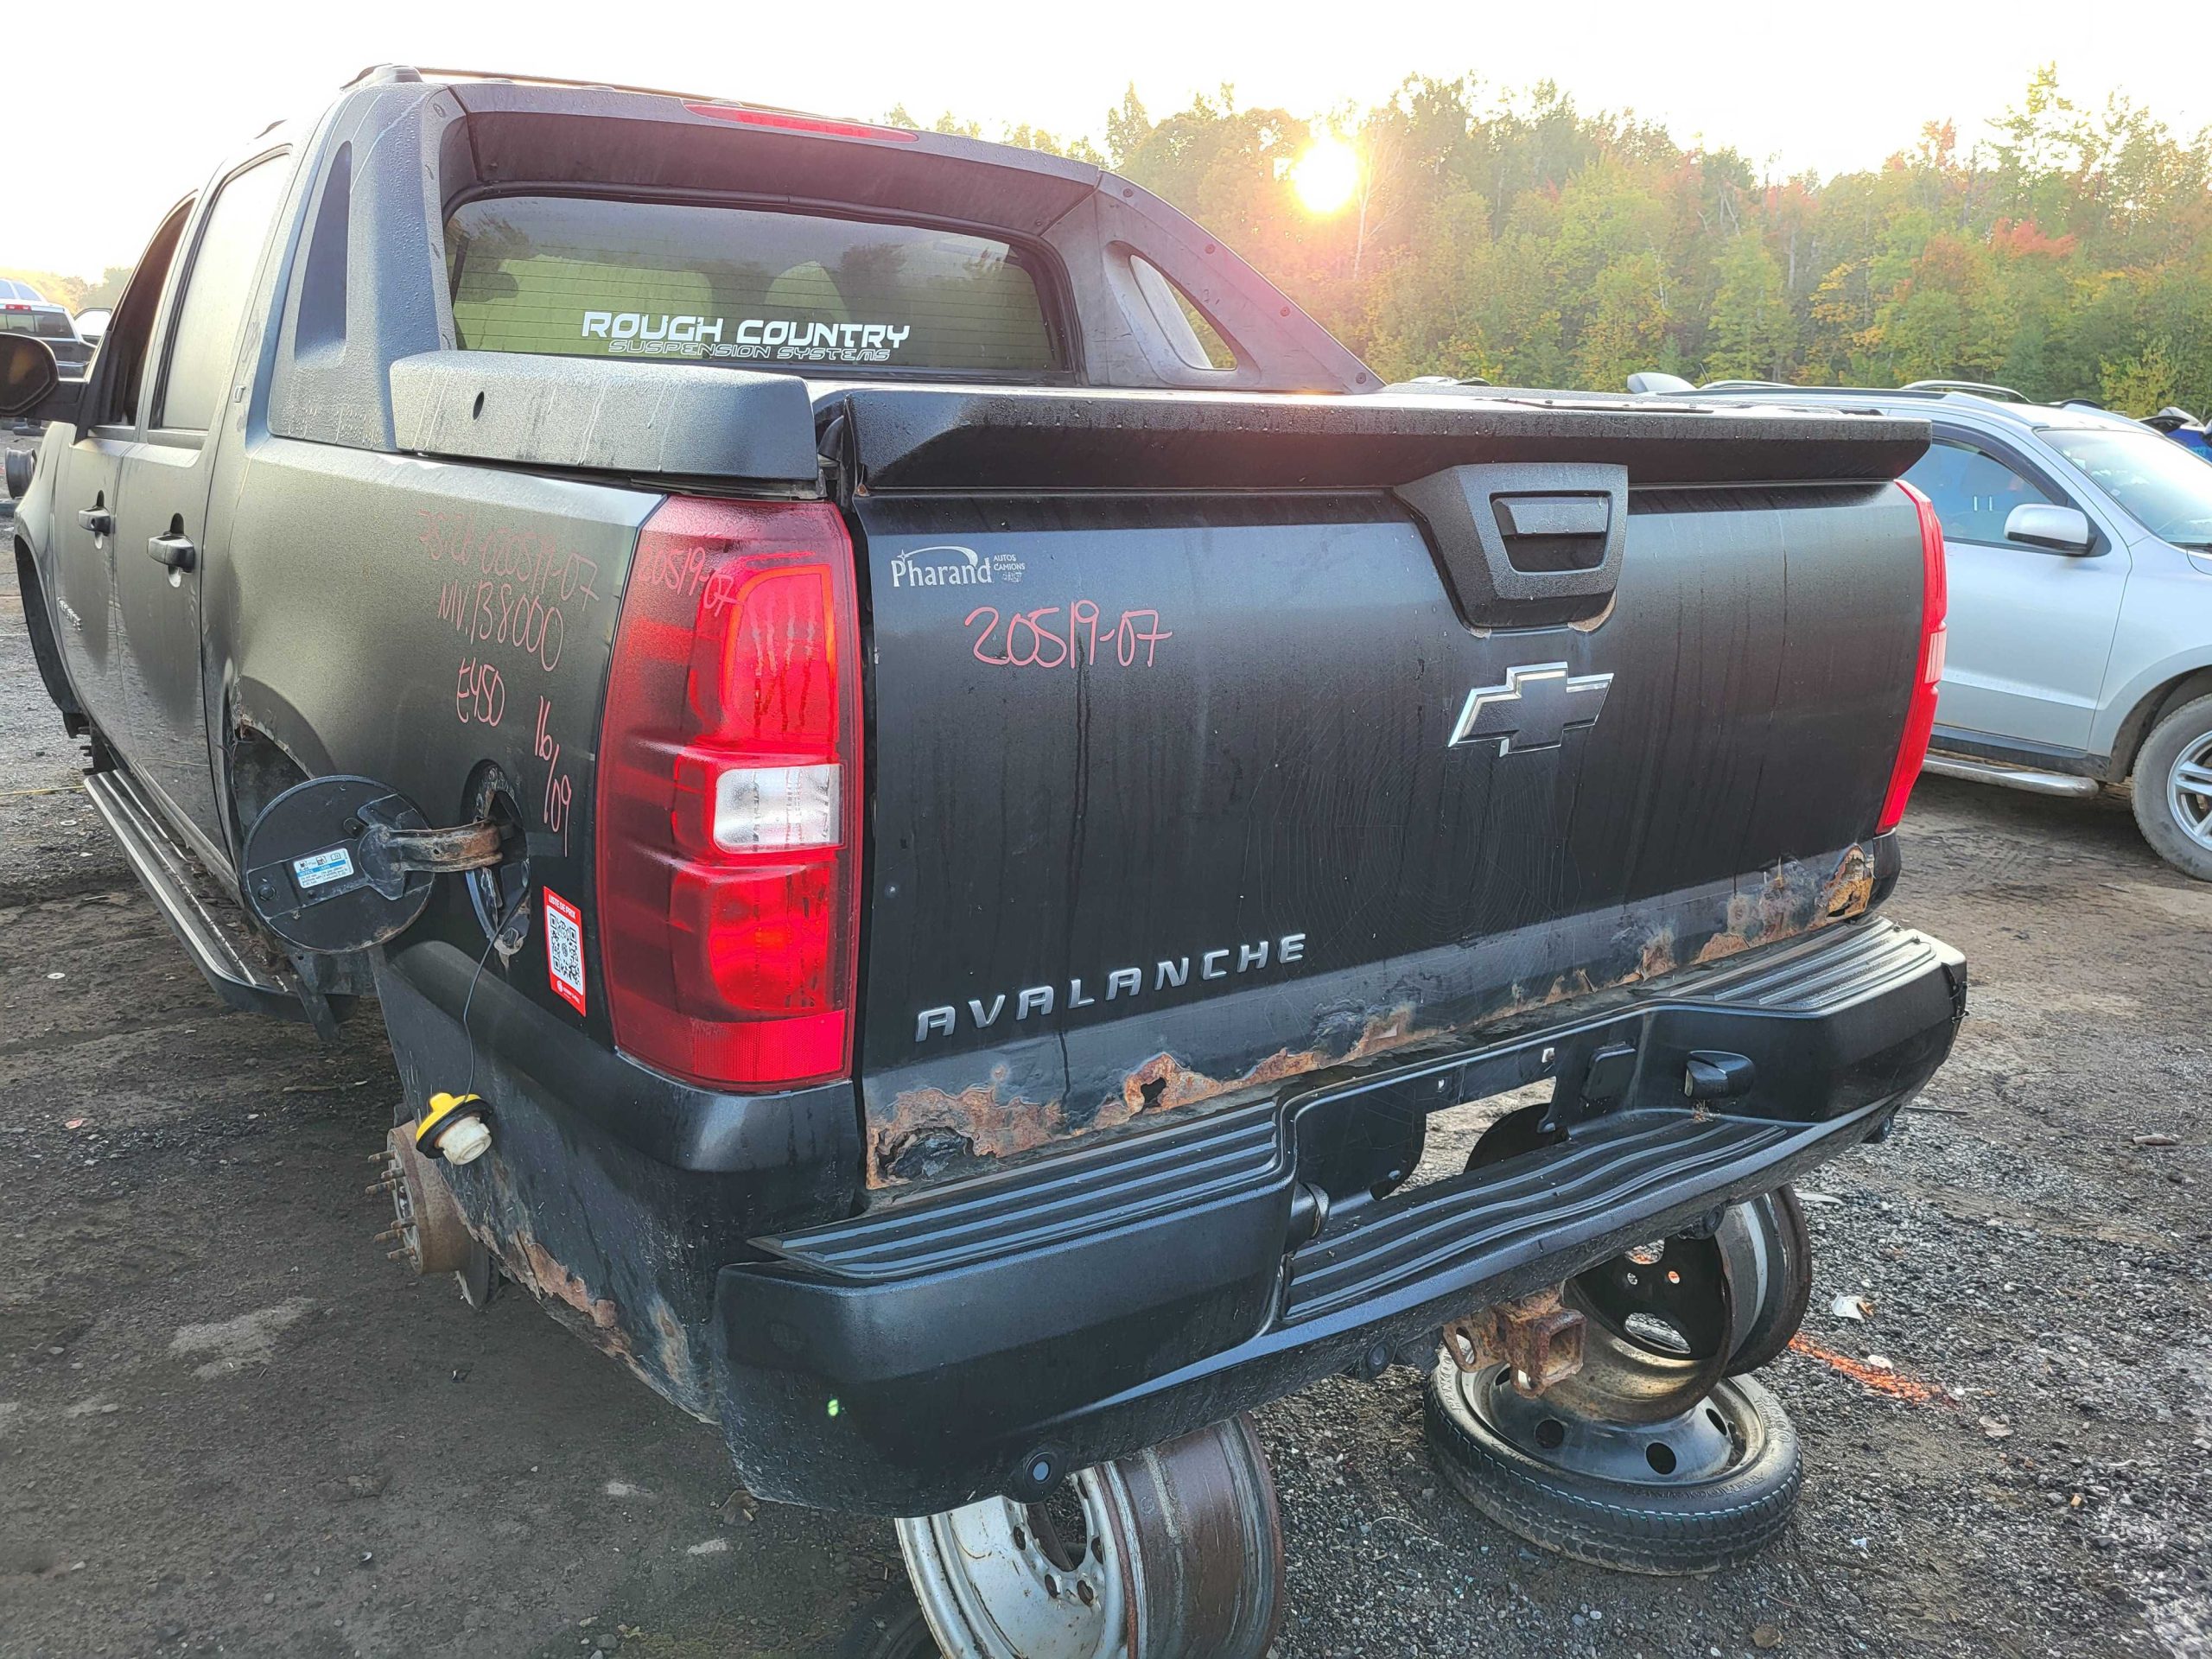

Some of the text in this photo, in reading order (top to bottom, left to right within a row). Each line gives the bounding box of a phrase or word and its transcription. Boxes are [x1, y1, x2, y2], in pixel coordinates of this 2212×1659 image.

[582, 311, 910, 348] ROUGH COUNTRY
[608, 340, 891, 362] SUSPENSION SYSTEMS
[891, 557, 993, 588] Pharand
[994, 563, 1026, 571] CAMIONS
[963, 599, 1173, 669] 20519-07
[915, 932, 1307, 1043] AVALANCHE
